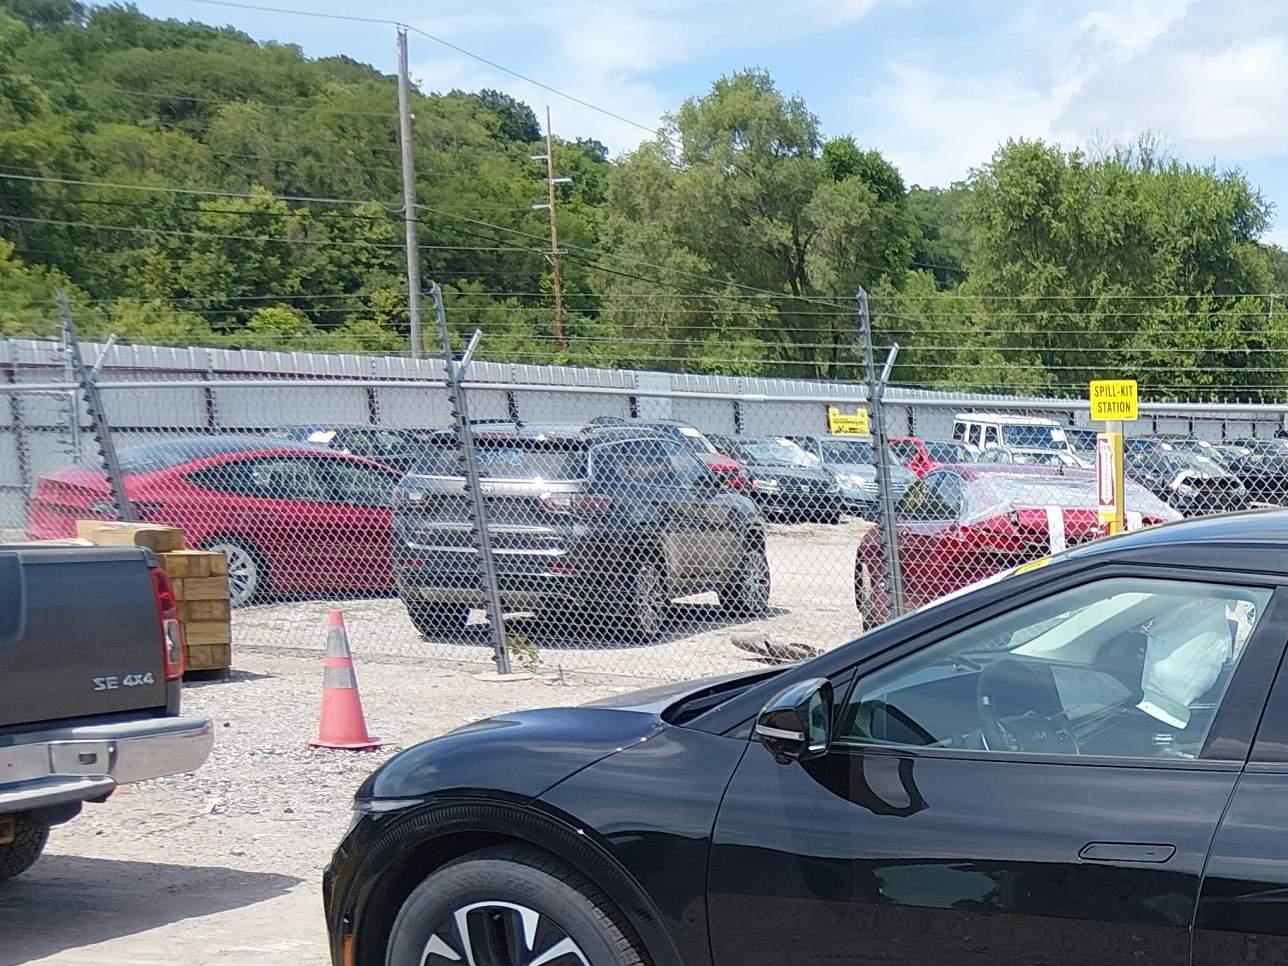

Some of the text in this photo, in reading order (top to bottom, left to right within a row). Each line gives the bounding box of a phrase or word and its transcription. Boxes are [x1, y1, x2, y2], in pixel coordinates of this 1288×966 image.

[1094, 384, 1133, 398] SPILL-KIT
[1097, 401, 1131, 413] STATION
[92, 676, 119, 692] SE
